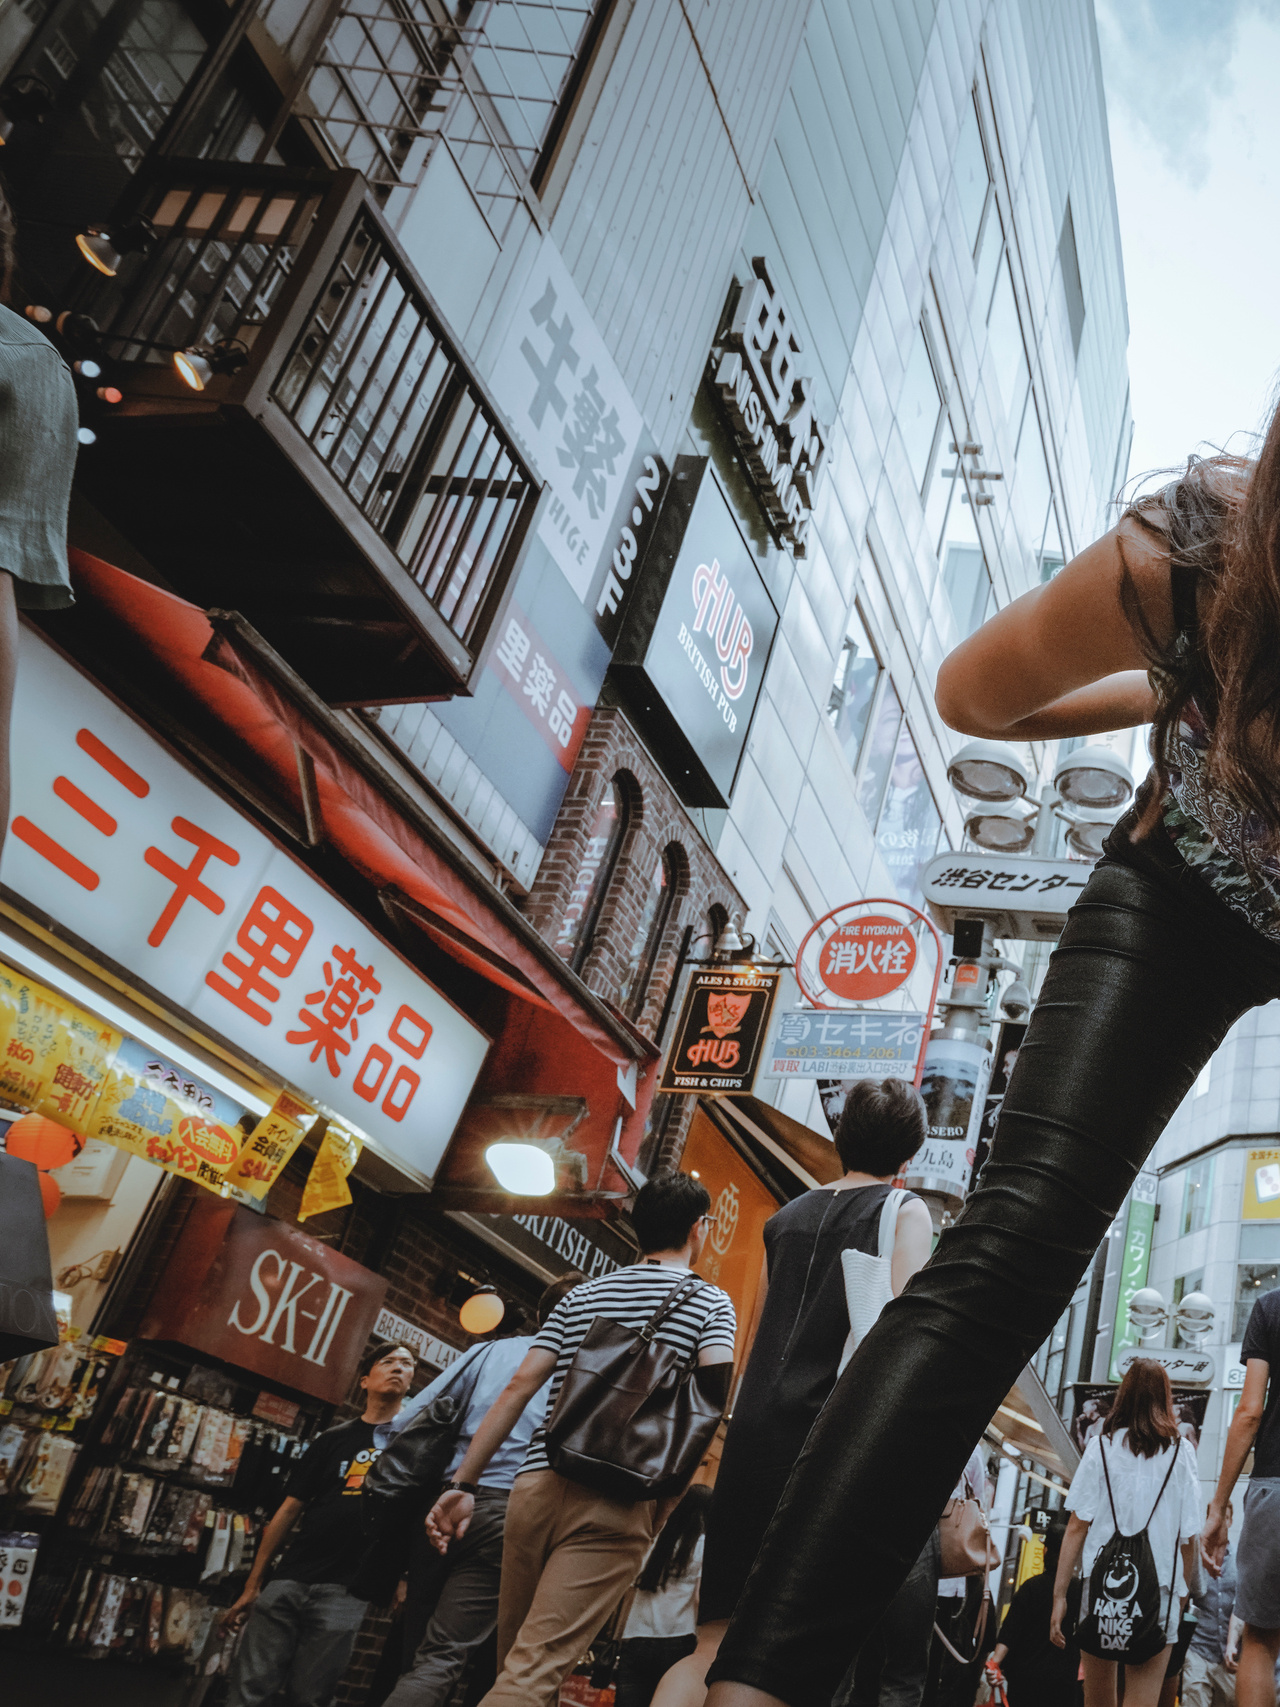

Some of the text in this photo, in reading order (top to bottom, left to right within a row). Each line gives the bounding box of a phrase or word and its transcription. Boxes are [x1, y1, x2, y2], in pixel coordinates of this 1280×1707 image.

[518, 276, 627, 520] 牛繁
[716, 355, 809, 557] NISHIMURA
[548, 496, 590, 566] HIGE
[692, 557, 754, 700] HUB
[677, 622, 738, 733] BRITISH PUB
[932, 868, 1087, 893] 渋谷センター
[11, 727, 434, 1123] 三千里薬品
[839, 925, 905, 936] FIRE HYDRANT
[826, 940, 912, 975] 消火栓
[696, 975, 773, 988] ALES & STOUTS
[687, 1039, 740, 1069] HUB
[799, 1046, 903, 1060] 03-3464-2061
[674, 1076, 743, 1088] FISH & CHIPS
[178, 1119, 234, 1164] 入会無料
[926, 1126, 964, 1137] SEBO
[238, 1157, 279, 1183] SALE
[512, 1212, 593, 1270] BRITISH
[227, 1248, 354, 1367] SK-II
[376, 1312, 463, 1370] BREWERY LAN
[1093, 1598, 1144, 1619] HAVE A
[1097, 1618, 1134, 1636] NIKE
[1101, 1633, 1130, 1651] DAY.
